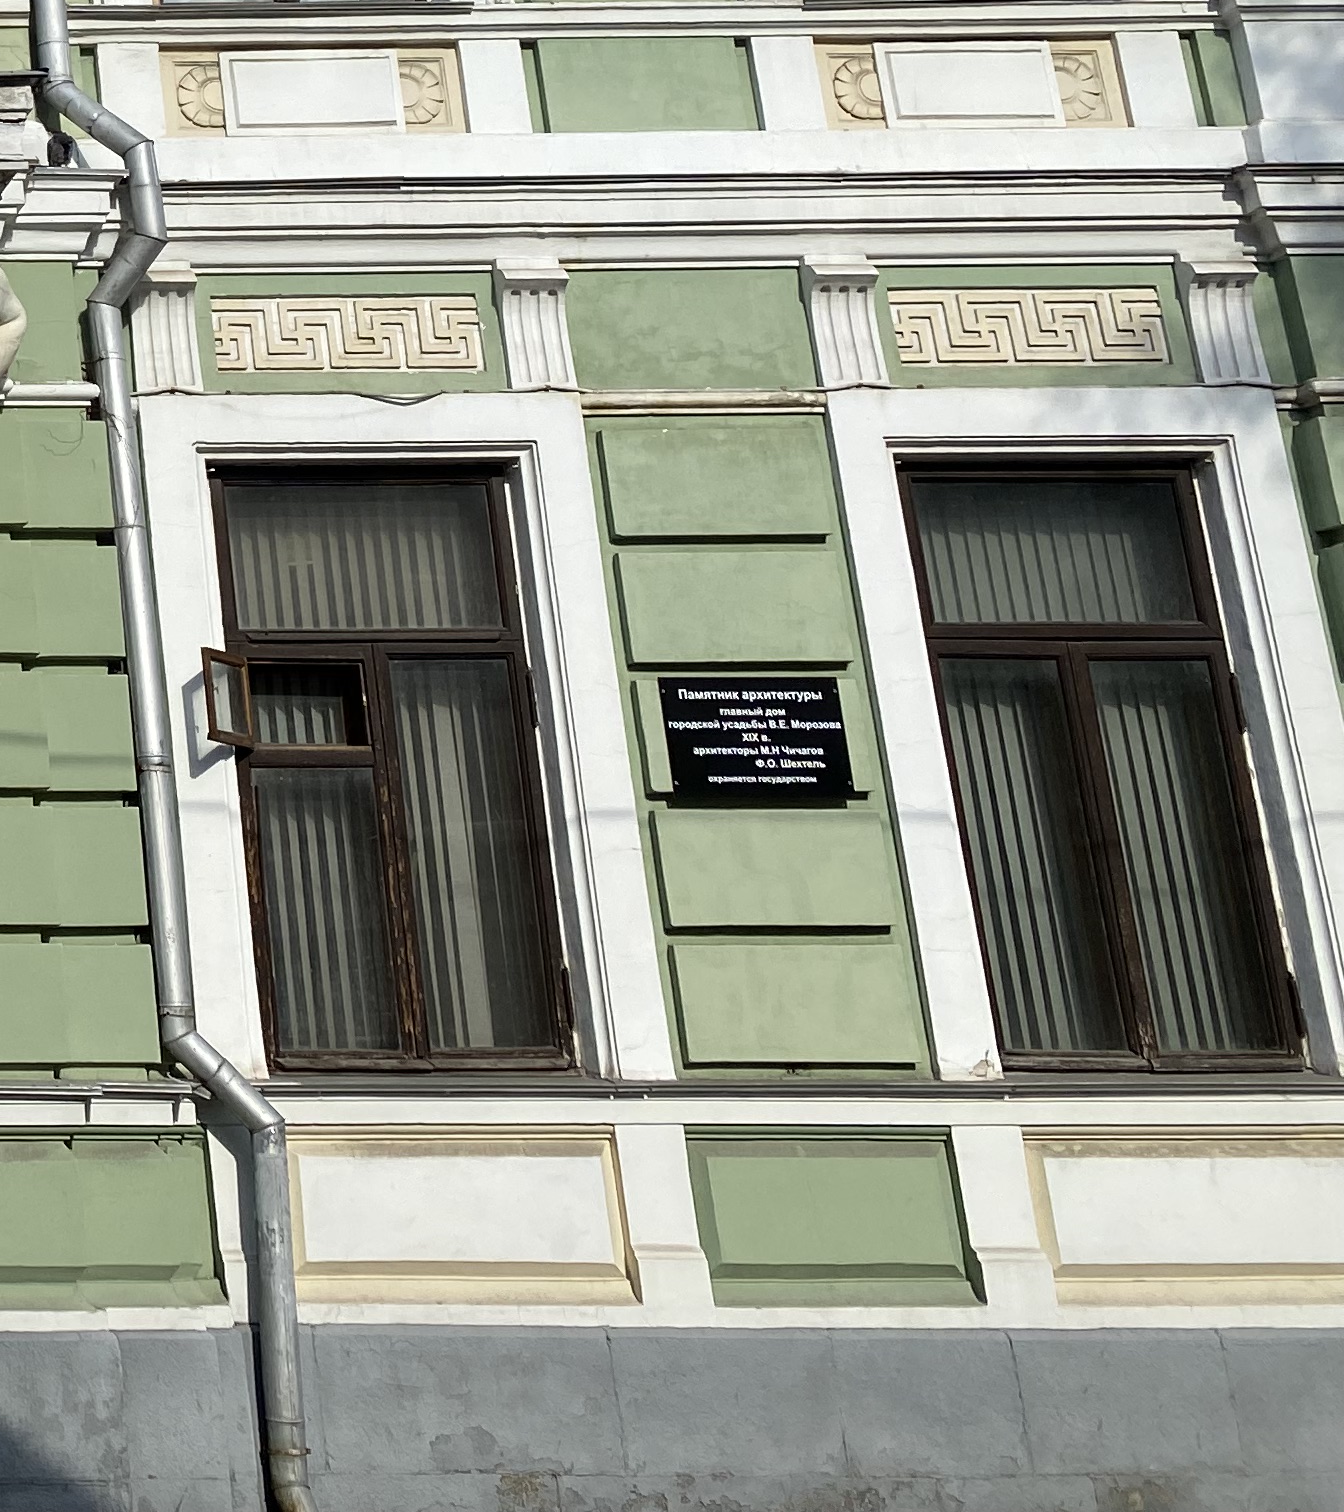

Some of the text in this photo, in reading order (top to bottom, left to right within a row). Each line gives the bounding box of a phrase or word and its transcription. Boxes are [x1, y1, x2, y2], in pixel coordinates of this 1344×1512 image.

[678, 689, 823, 702] Памятник архитектуры
[719, 707, 786, 718] главный дом
[668, 720, 841, 730] городской усадьбы В.Е. Морозова
[761, 734, 771, 742] в.
[693, 746, 759, 757] архитекторы
[781, 746, 824, 755] Чичагов
[755, 759, 826, 768] Ф.О. Шехтель
[708, 775, 817, 785] охраняется государством
